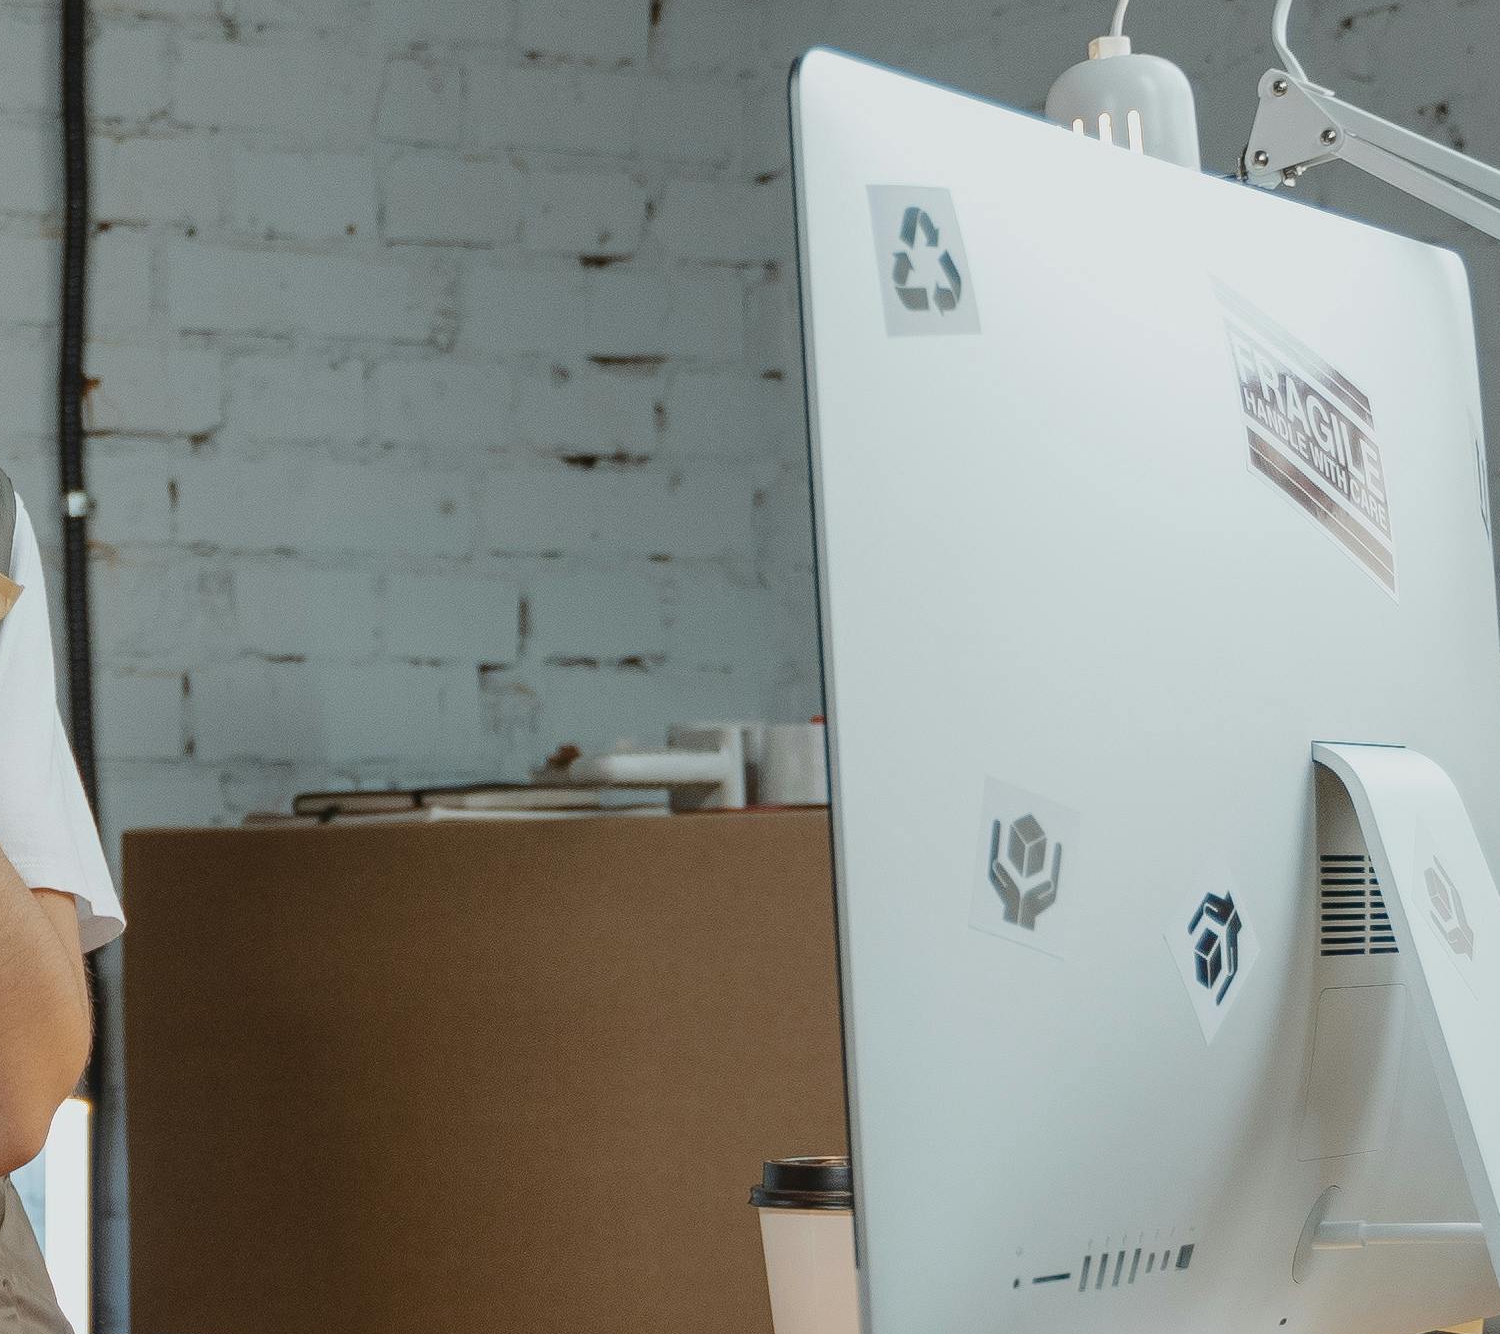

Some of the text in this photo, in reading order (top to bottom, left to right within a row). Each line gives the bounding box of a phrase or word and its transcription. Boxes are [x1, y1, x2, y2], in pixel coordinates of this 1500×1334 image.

[1233, 342, 1384, 502] FRAGILE
[1243, 386, 1388, 530] HANDLE WITH CARE
